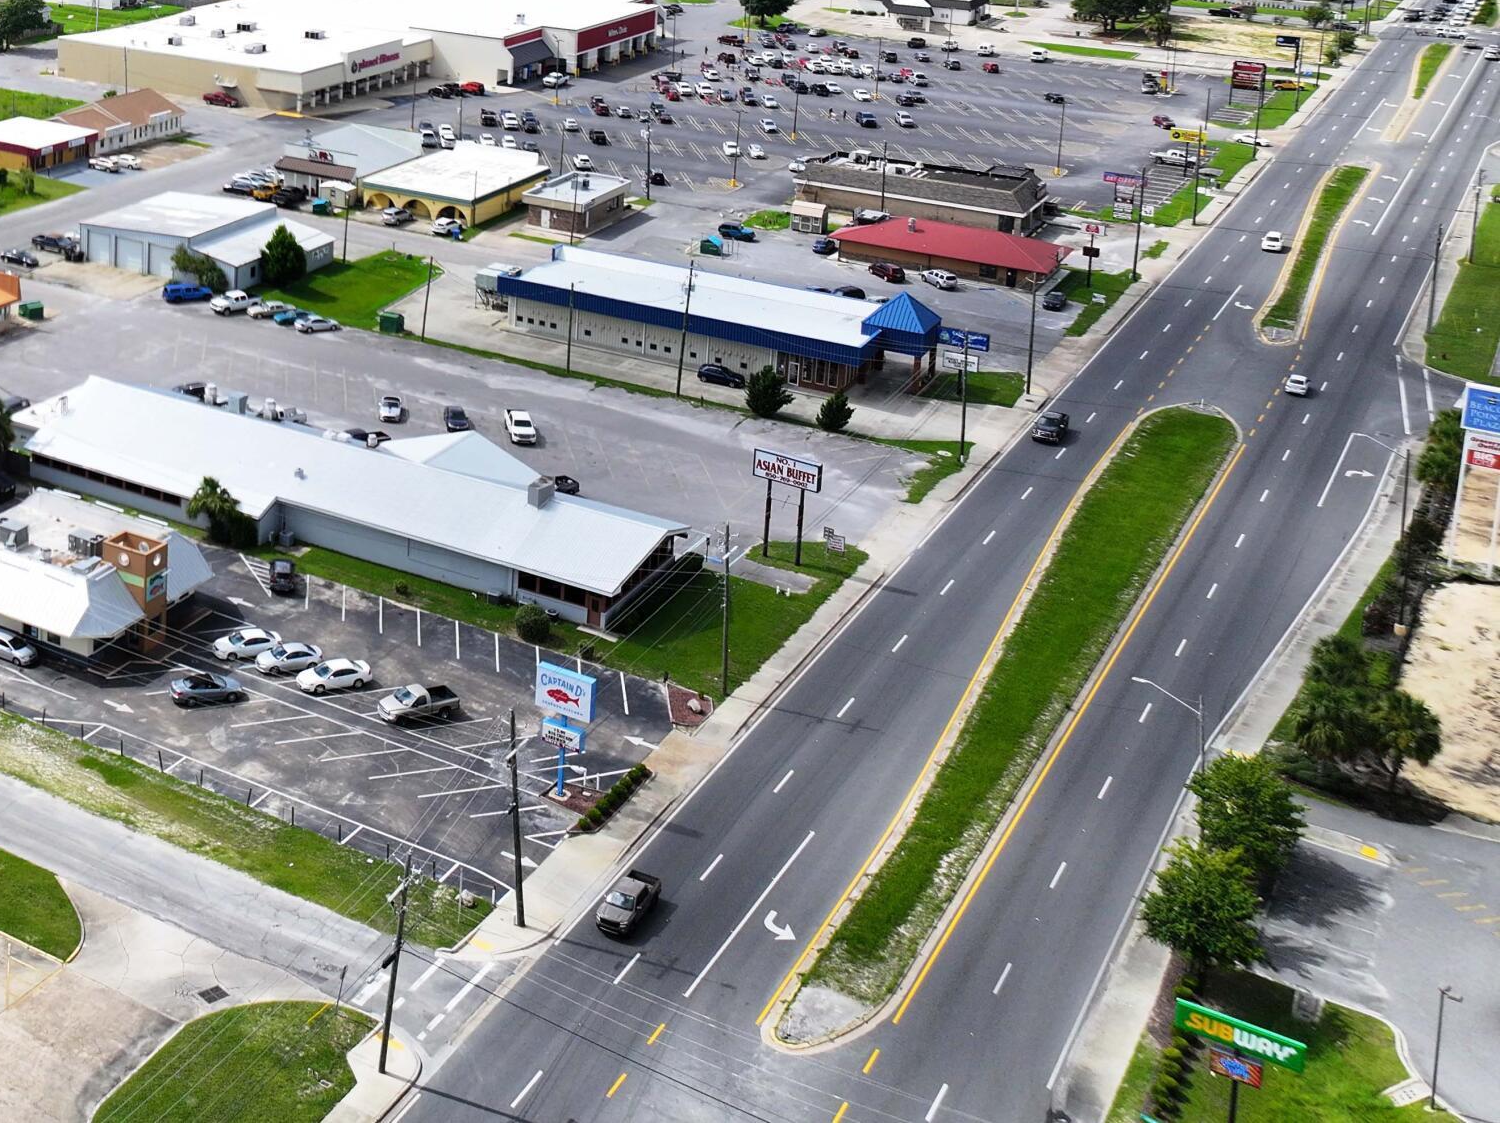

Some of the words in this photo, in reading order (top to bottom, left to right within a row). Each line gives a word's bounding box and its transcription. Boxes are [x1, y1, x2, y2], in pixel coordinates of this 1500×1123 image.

[756, 459, 784, 476] ASIAN
[786, 466, 817, 484] BUFFET
[776, 456, 791, 466] NO.
[1184, 1011, 1298, 1064] SUBWAY
